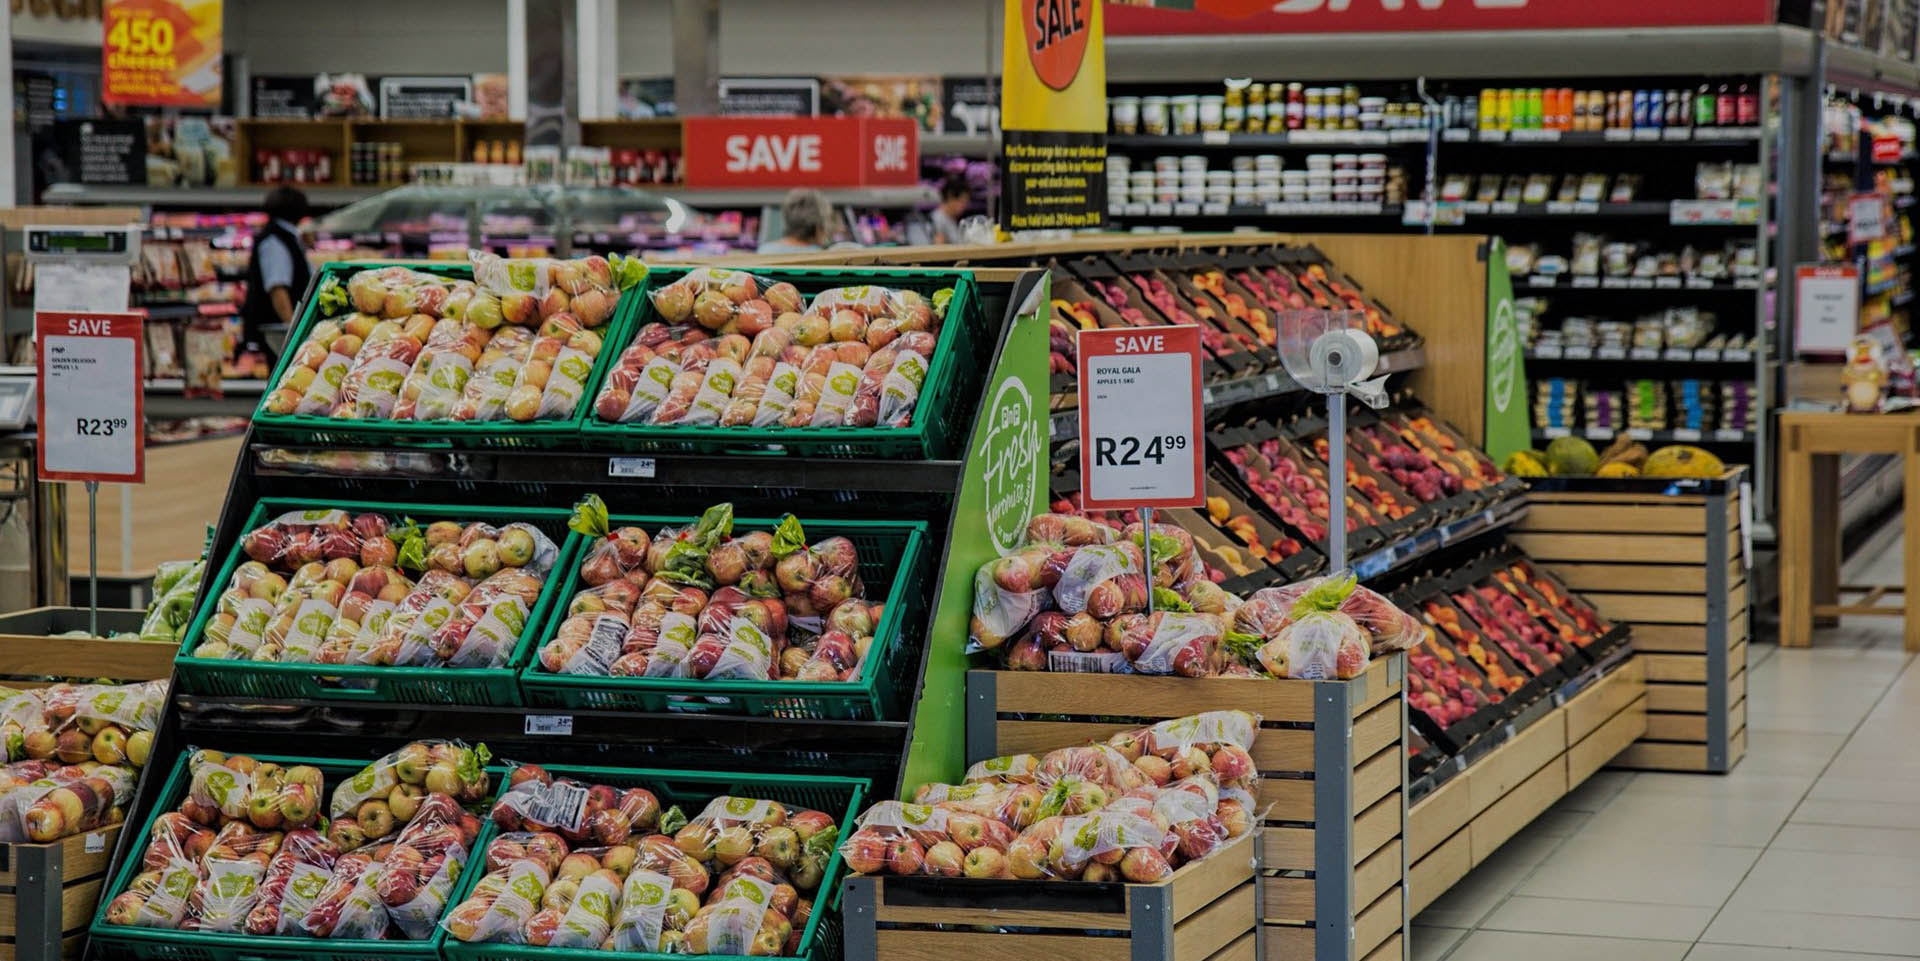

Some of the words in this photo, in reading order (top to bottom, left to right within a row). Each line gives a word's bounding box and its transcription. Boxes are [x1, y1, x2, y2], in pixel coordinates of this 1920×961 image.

[108, 17, 174, 55] 450
[1034, 0, 1084, 51] SALE
[726, 135, 822, 172] SAVE
[874, 134, 908, 172] SAVE
[68, 319, 112, 335] SAVE
[1115, 336, 1164, 353] SAVE
[1096, 367, 1120, 375] ROYAL
[1121, 366, 1141, 374] GALA
[980, 419, 1042, 494] Fresh
